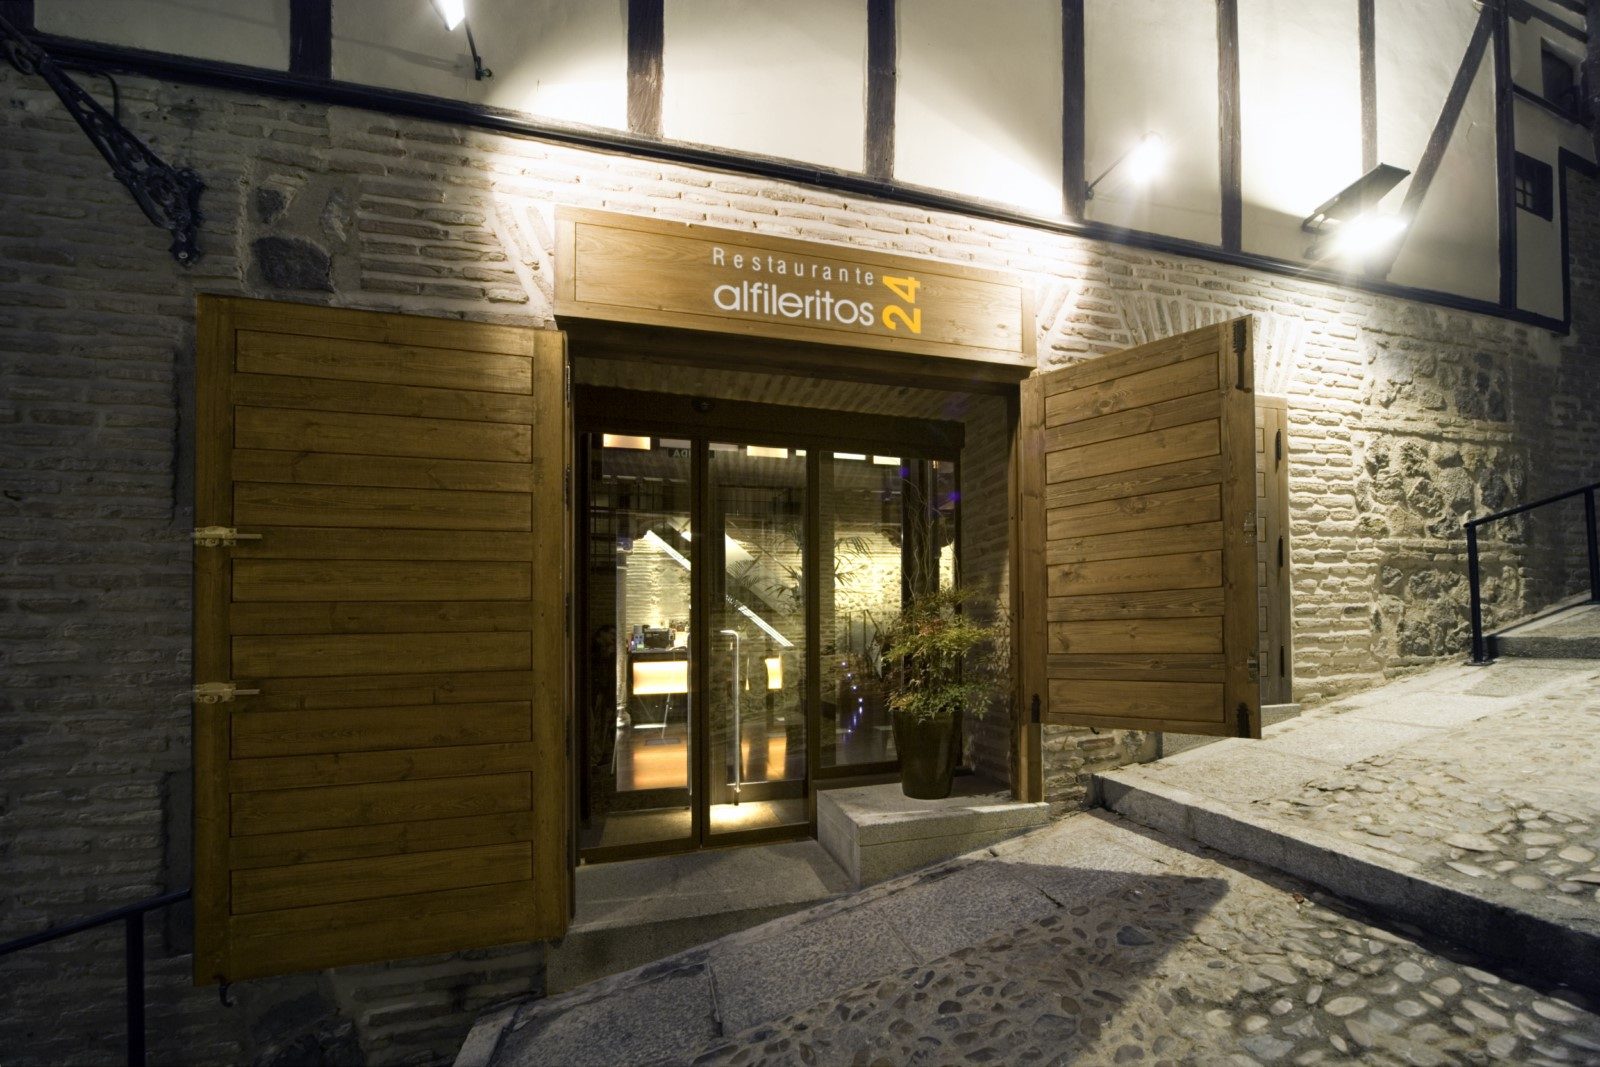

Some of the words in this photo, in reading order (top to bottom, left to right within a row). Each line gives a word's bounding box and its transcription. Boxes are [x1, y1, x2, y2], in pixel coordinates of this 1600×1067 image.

[712, 247, 874, 286] Restaurante
[713, 280, 875, 326] alfileritos
[882, 275, 922, 334] 24
